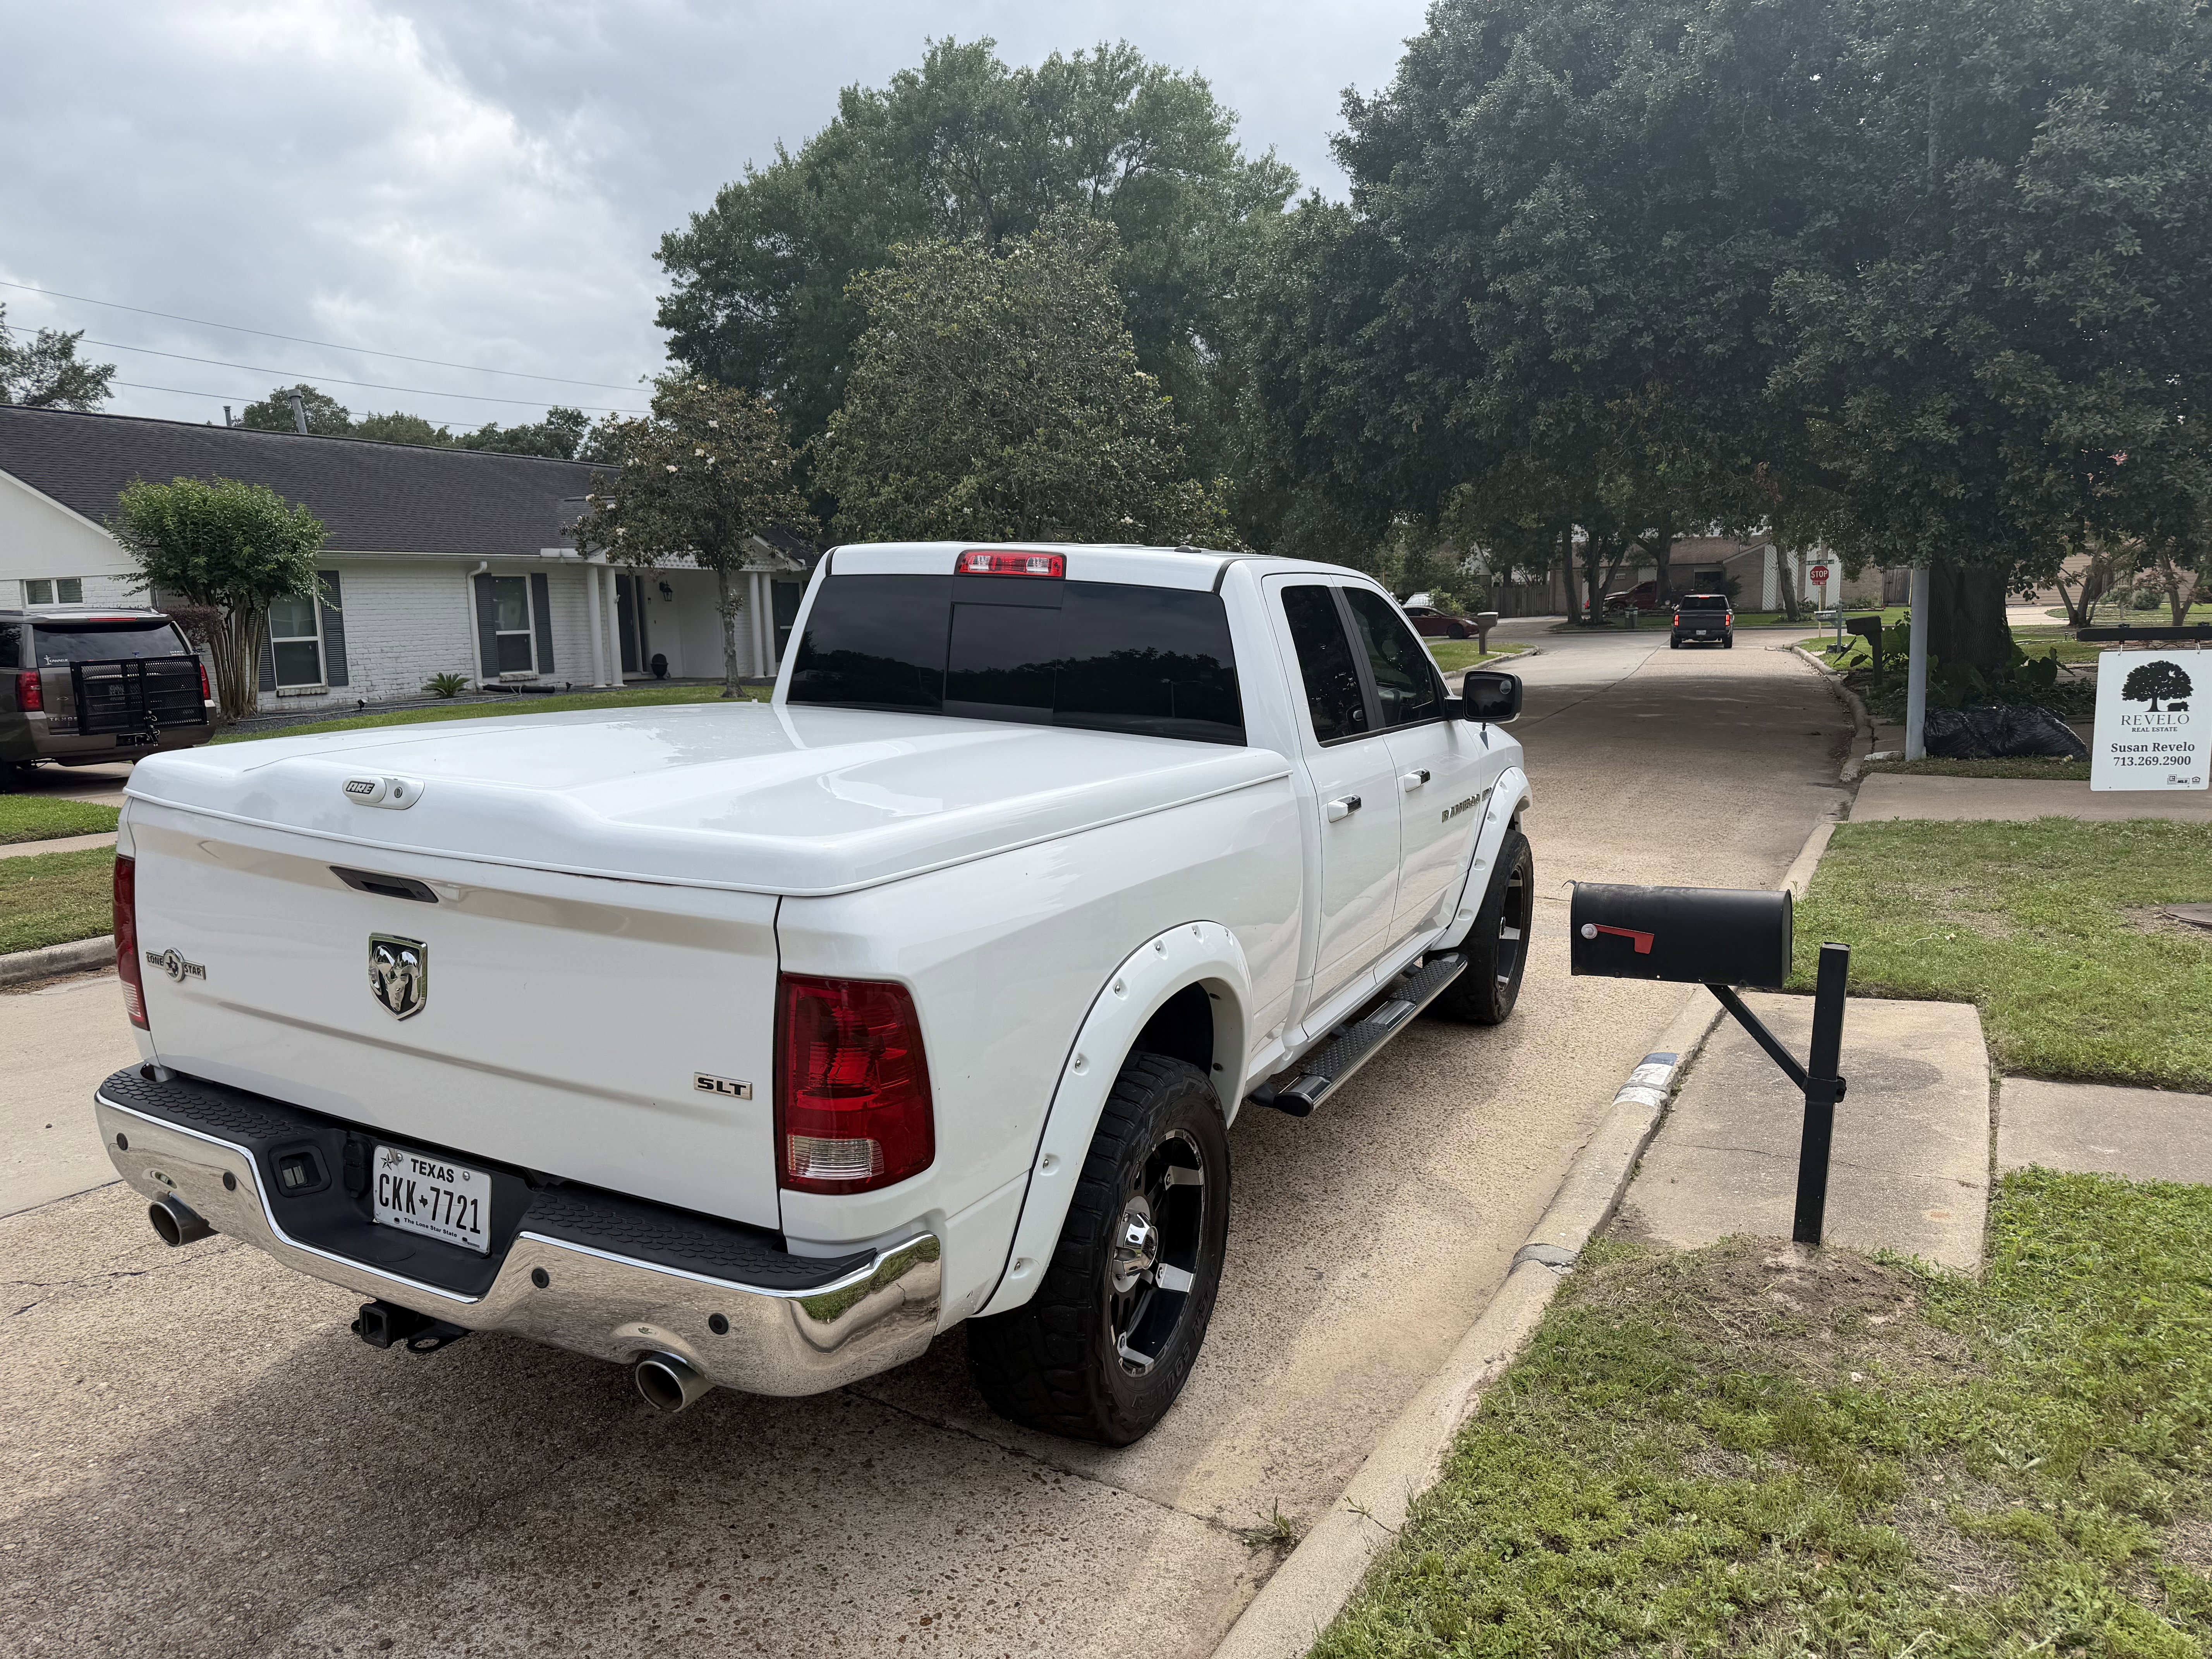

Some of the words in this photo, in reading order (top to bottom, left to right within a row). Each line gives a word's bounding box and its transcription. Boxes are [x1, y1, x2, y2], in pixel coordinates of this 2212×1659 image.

[2121, 714, 2189, 725] REVELO
[2111, 743, 2148, 752] Susan
[2152, 742, 2195, 751] Revelo
[2114, 756, 2191, 766] 713.269.2900
[147, 954, 163, 966] LONE
[184, 964, 201, 976] STAR
[698, 1077, 746, 1096] SLT
[411, 1158, 454, 1183] TEXAS
[416, 1221, 429, 1229] Lone
[443, 1229, 457, 1237] State
